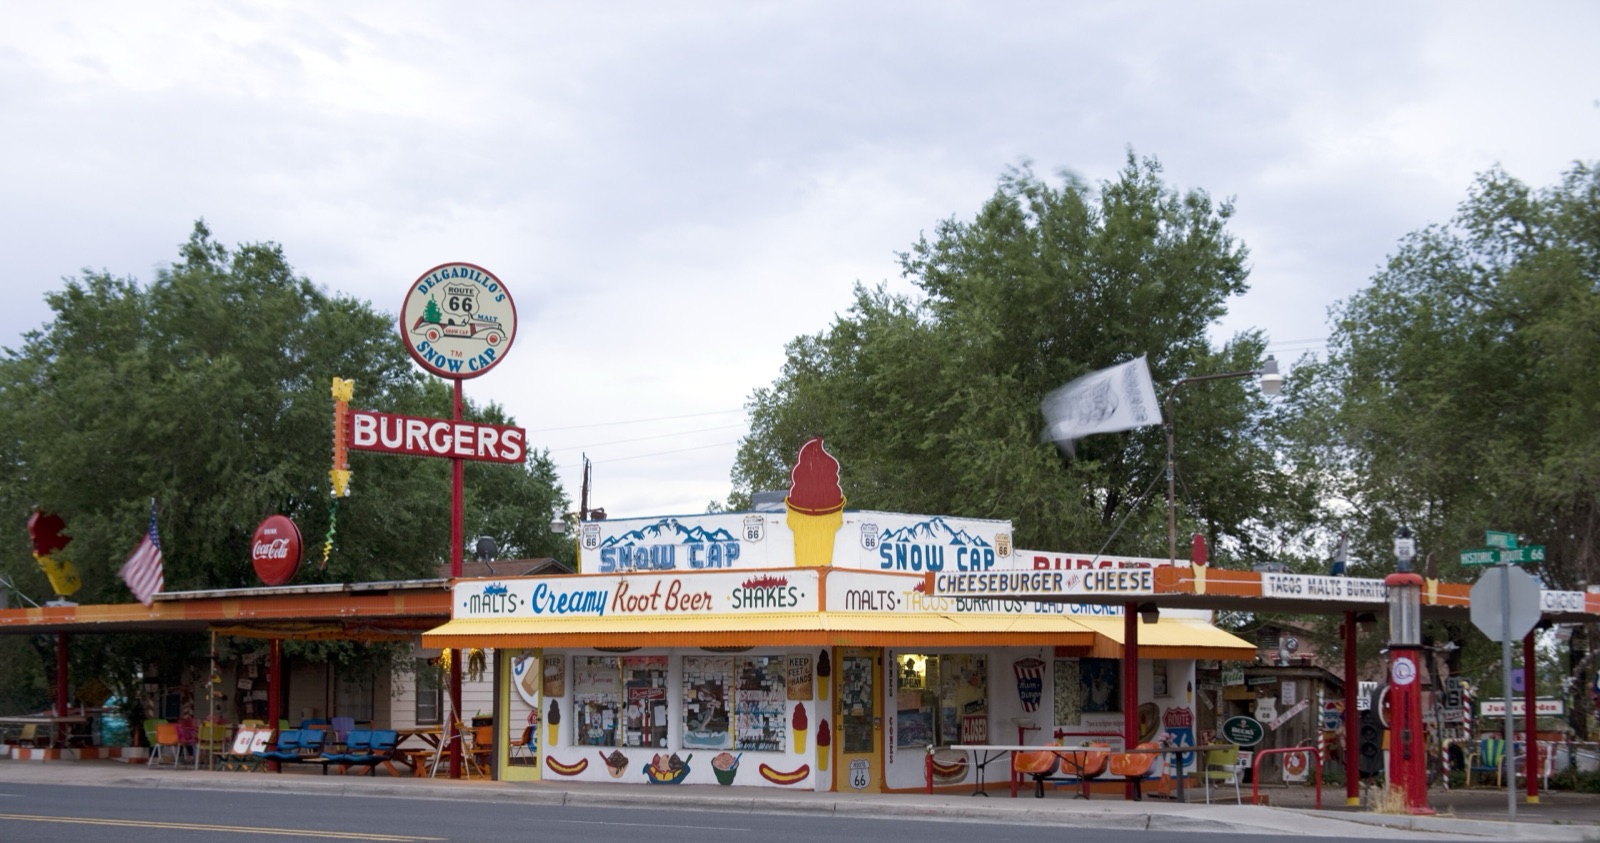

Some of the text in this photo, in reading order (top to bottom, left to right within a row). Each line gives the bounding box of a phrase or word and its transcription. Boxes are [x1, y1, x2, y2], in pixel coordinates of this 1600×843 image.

[417, 267, 506, 303] DELGADILLO'S
[448, 287, 474, 295] ROUTE
[448, 297, 472, 312] 66
[477, 314, 498, 322] MALT
[416, 340, 497, 373] SNOW CAP
[450, 350, 463, 358] TM
[353, 413, 522, 460] BURGERS
[747, 530, 759, 540] 66
[586, 538, 597, 547] 66
[865, 538, 876, 548] 66
[600, 542, 741, 573] SNOW CAP
[880, 543, 995, 572] SNOW CAP
[998, 546, 1008, 556] 66
[1461, 548, 1544, 564] HISTORIC ROUTE 66
[936, 572, 1064, 594] CHEESEBURGER
[1083, 571, 1152, 592] CHEESE
[1269, 576, 1302, 594] TACOS
[1308, 578, 1342, 596] MALTS
[470, 578, 798, 616] MALTS Creamy Root Beer SHAKES
[846, 590, 896, 610] MALTS
[902, 591, 948, 611] TACOS
[956, 597, 1022, 612] BURRITOS
[790, 658, 809, 666] KEEP
[789, 668, 803, 676] FEET
[792, 674, 812, 686] HANDS
[1167, 714, 1190, 726] ROUTE
[964, 718, 986, 742] CLOSED
[854, 775, 866, 787] 66
